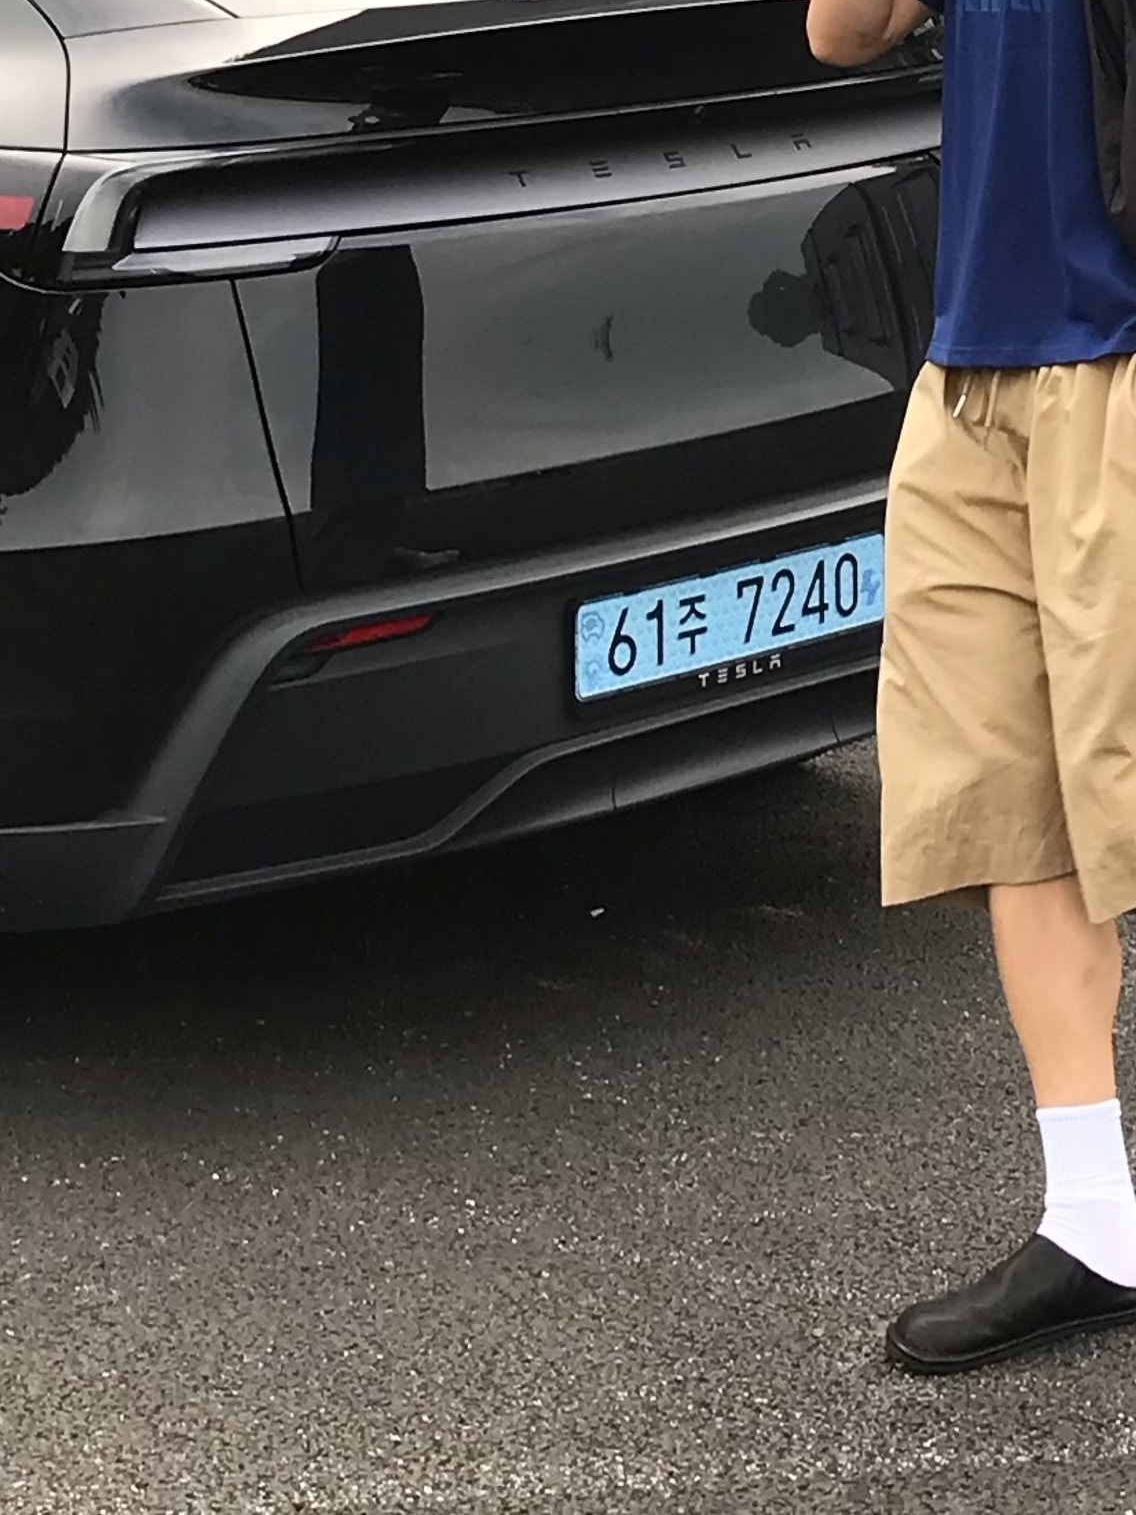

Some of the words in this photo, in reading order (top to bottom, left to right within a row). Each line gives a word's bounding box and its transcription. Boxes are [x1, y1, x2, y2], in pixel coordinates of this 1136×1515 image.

[508, 133, 812, 188] TESLA
[607, 592, 708, 677] 61주
[736, 552, 859, 644] 7240
[698, 653, 782, 688] TESLA
